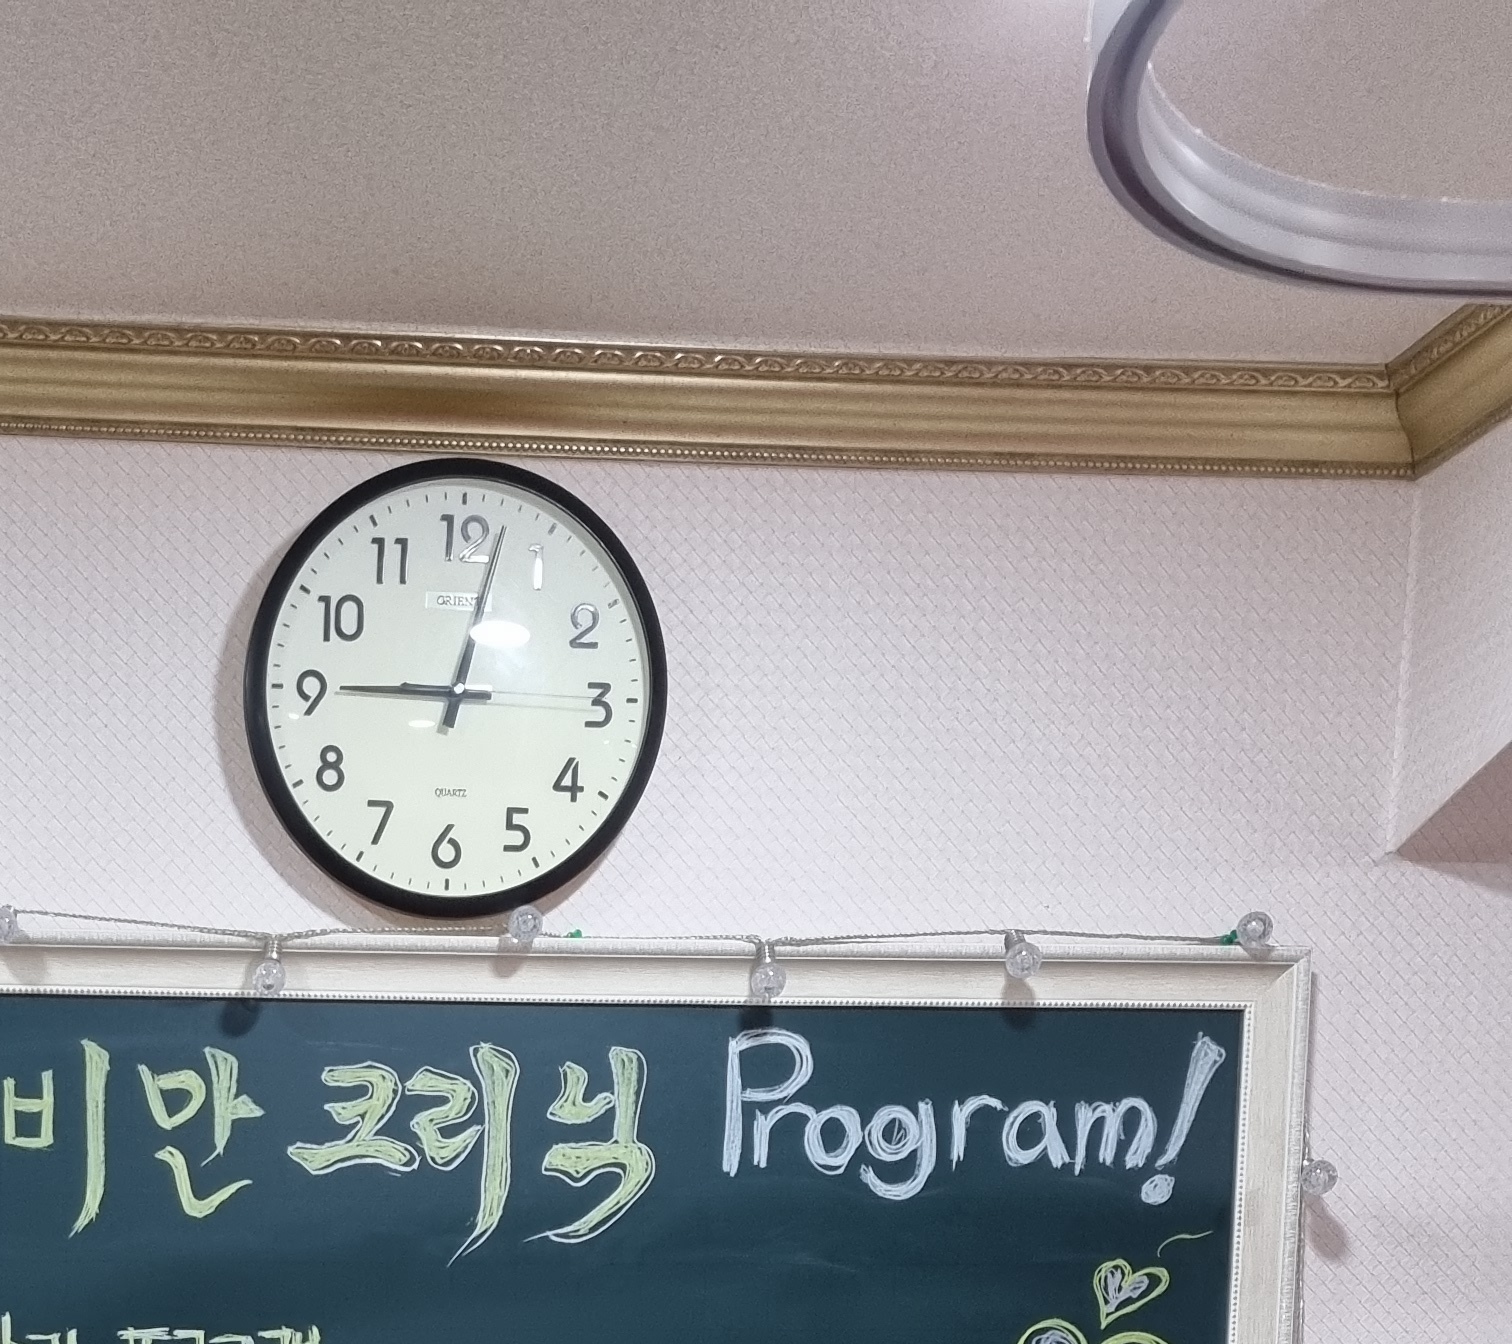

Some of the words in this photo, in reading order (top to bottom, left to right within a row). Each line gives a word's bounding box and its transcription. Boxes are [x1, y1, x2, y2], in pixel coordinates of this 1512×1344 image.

[371, 537, 409, 585] 11
[440, 513, 490, 564] 12
[528, 542, 545, 591] 1
[317, 593, 365, 643] 10
[437, 594, 481, 606] ORIEN
[569, 602, 600, 649] 2
[295, 668, 328, 717] 9
[584, 681, 613, 728] 3
[315, 744, 346, 793] 8
[551, 756, 584, 803] 4
[434, 787, 468, 798] QUARTZ
[367, 799, 394, 846] 7
[430, 823, 462, 869] 6
[503, 807, 532, 853] 5
[722, 1027, 1226, 1206] Program!
